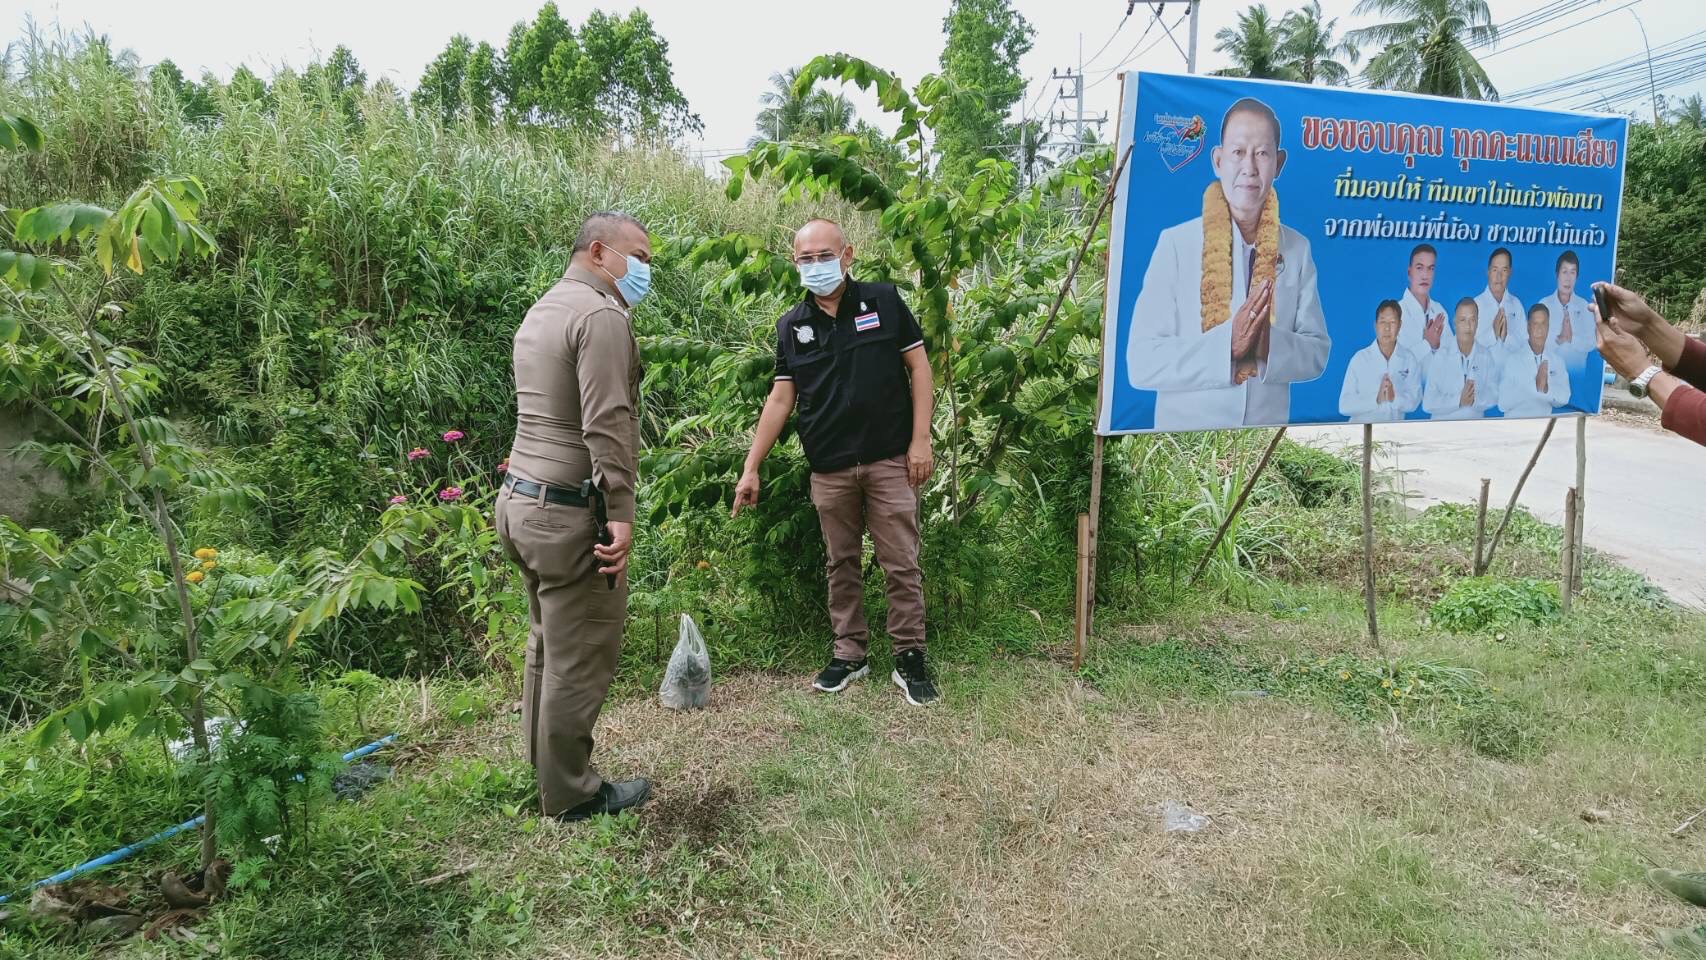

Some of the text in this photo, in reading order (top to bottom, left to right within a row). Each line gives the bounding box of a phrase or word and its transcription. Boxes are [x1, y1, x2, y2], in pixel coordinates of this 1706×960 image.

[1302, 116, 1618, 171] ขอขอบคุณ ทุกคะแนนเสียง
[1334, 167, 1603, 210] ที่มอบให้ ทีมเขาไม้แก้วพัฒนา
[1324, 212, 1606, 246] จากพ่อแม่พี่น้อง ชาวเขาไม้แก้ว
